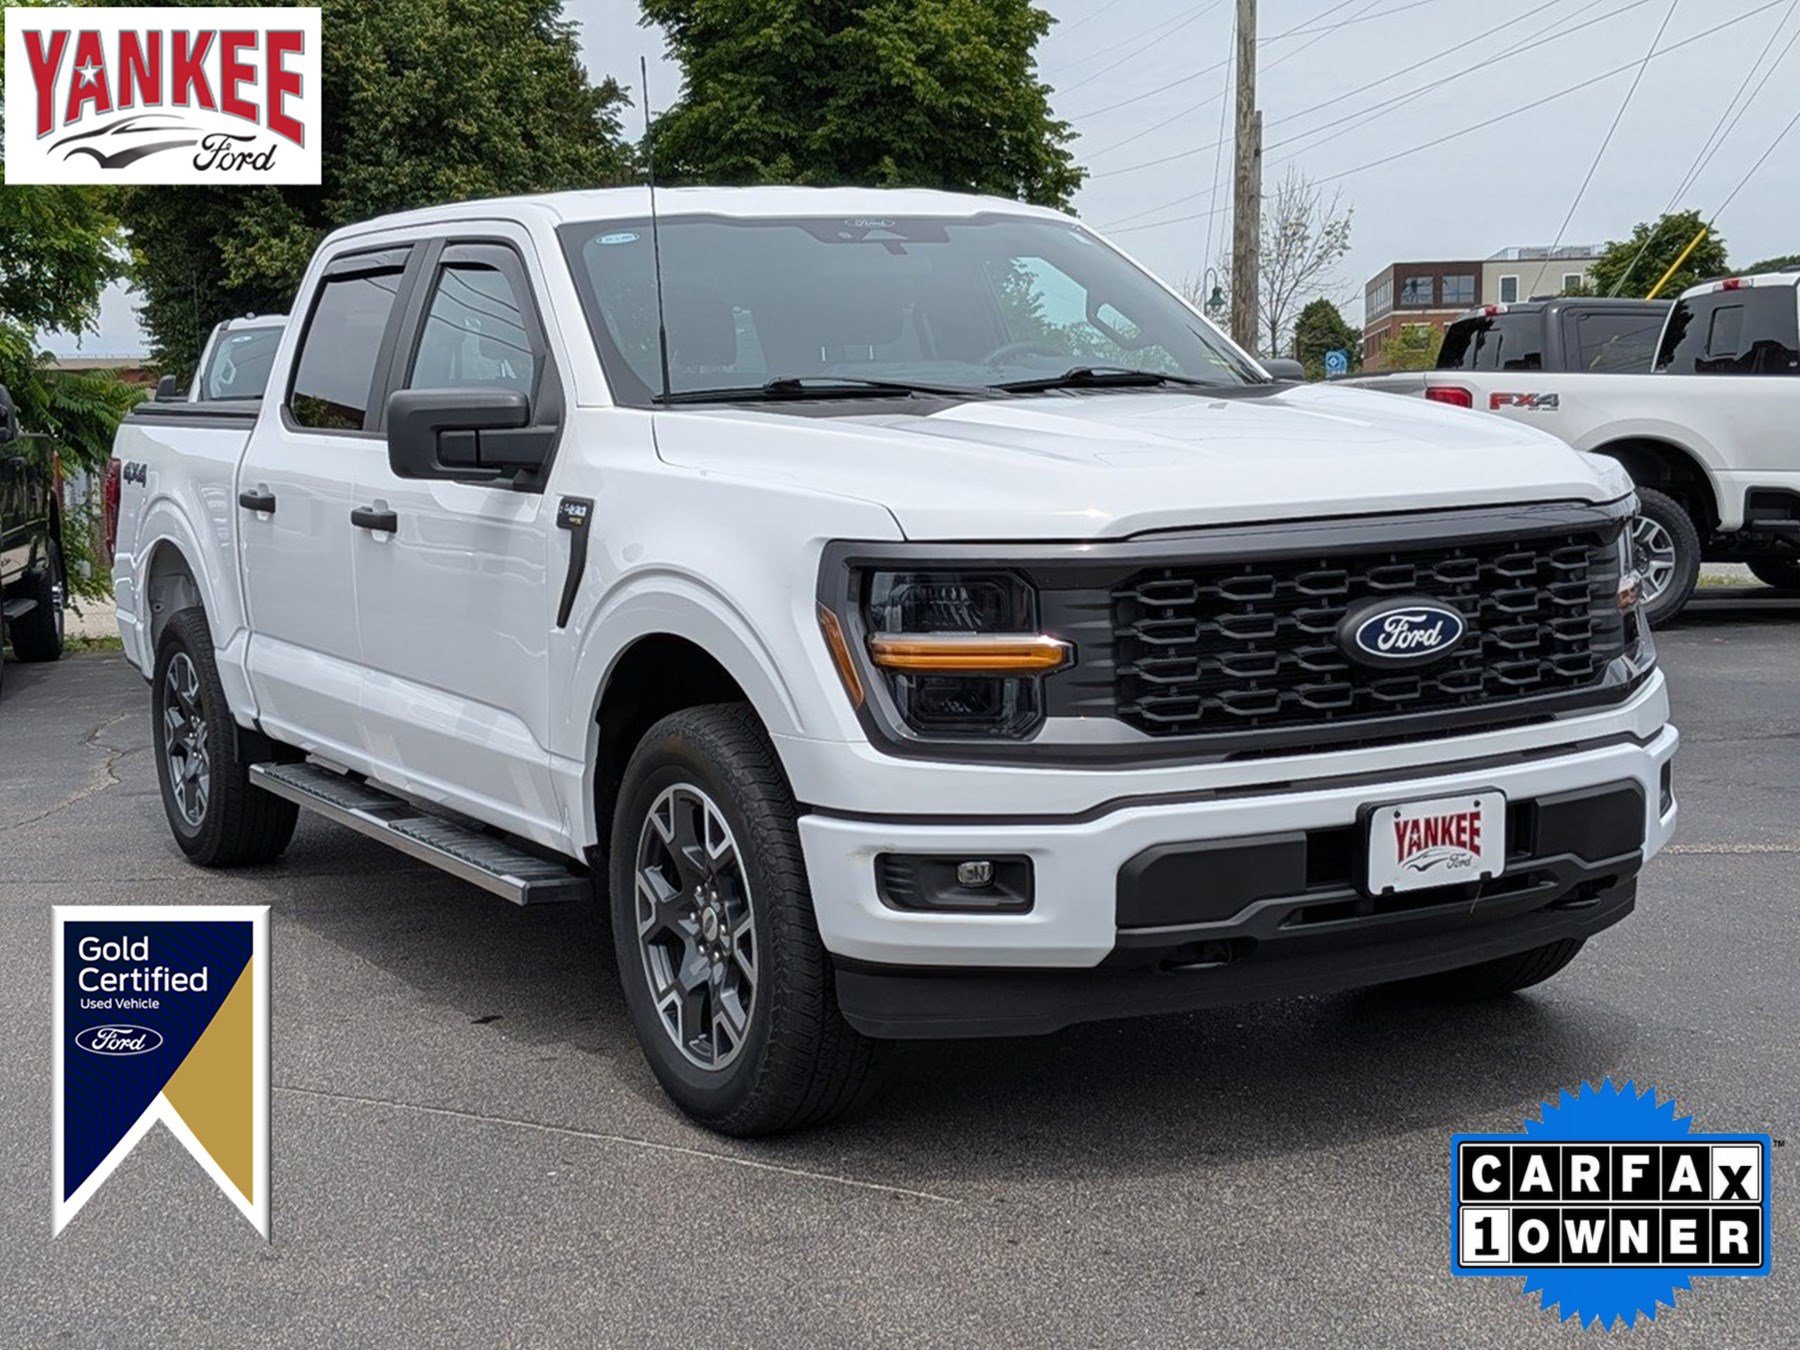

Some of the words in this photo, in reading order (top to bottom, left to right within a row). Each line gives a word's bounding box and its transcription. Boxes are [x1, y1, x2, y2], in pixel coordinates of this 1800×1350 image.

[1490, 392, 1559, 410] FX4
[1377, 614, 1443, 650] Ford
[1394, 811, 1481, 865] YANKEE
[1446, 853, 1473, 869] Ford
